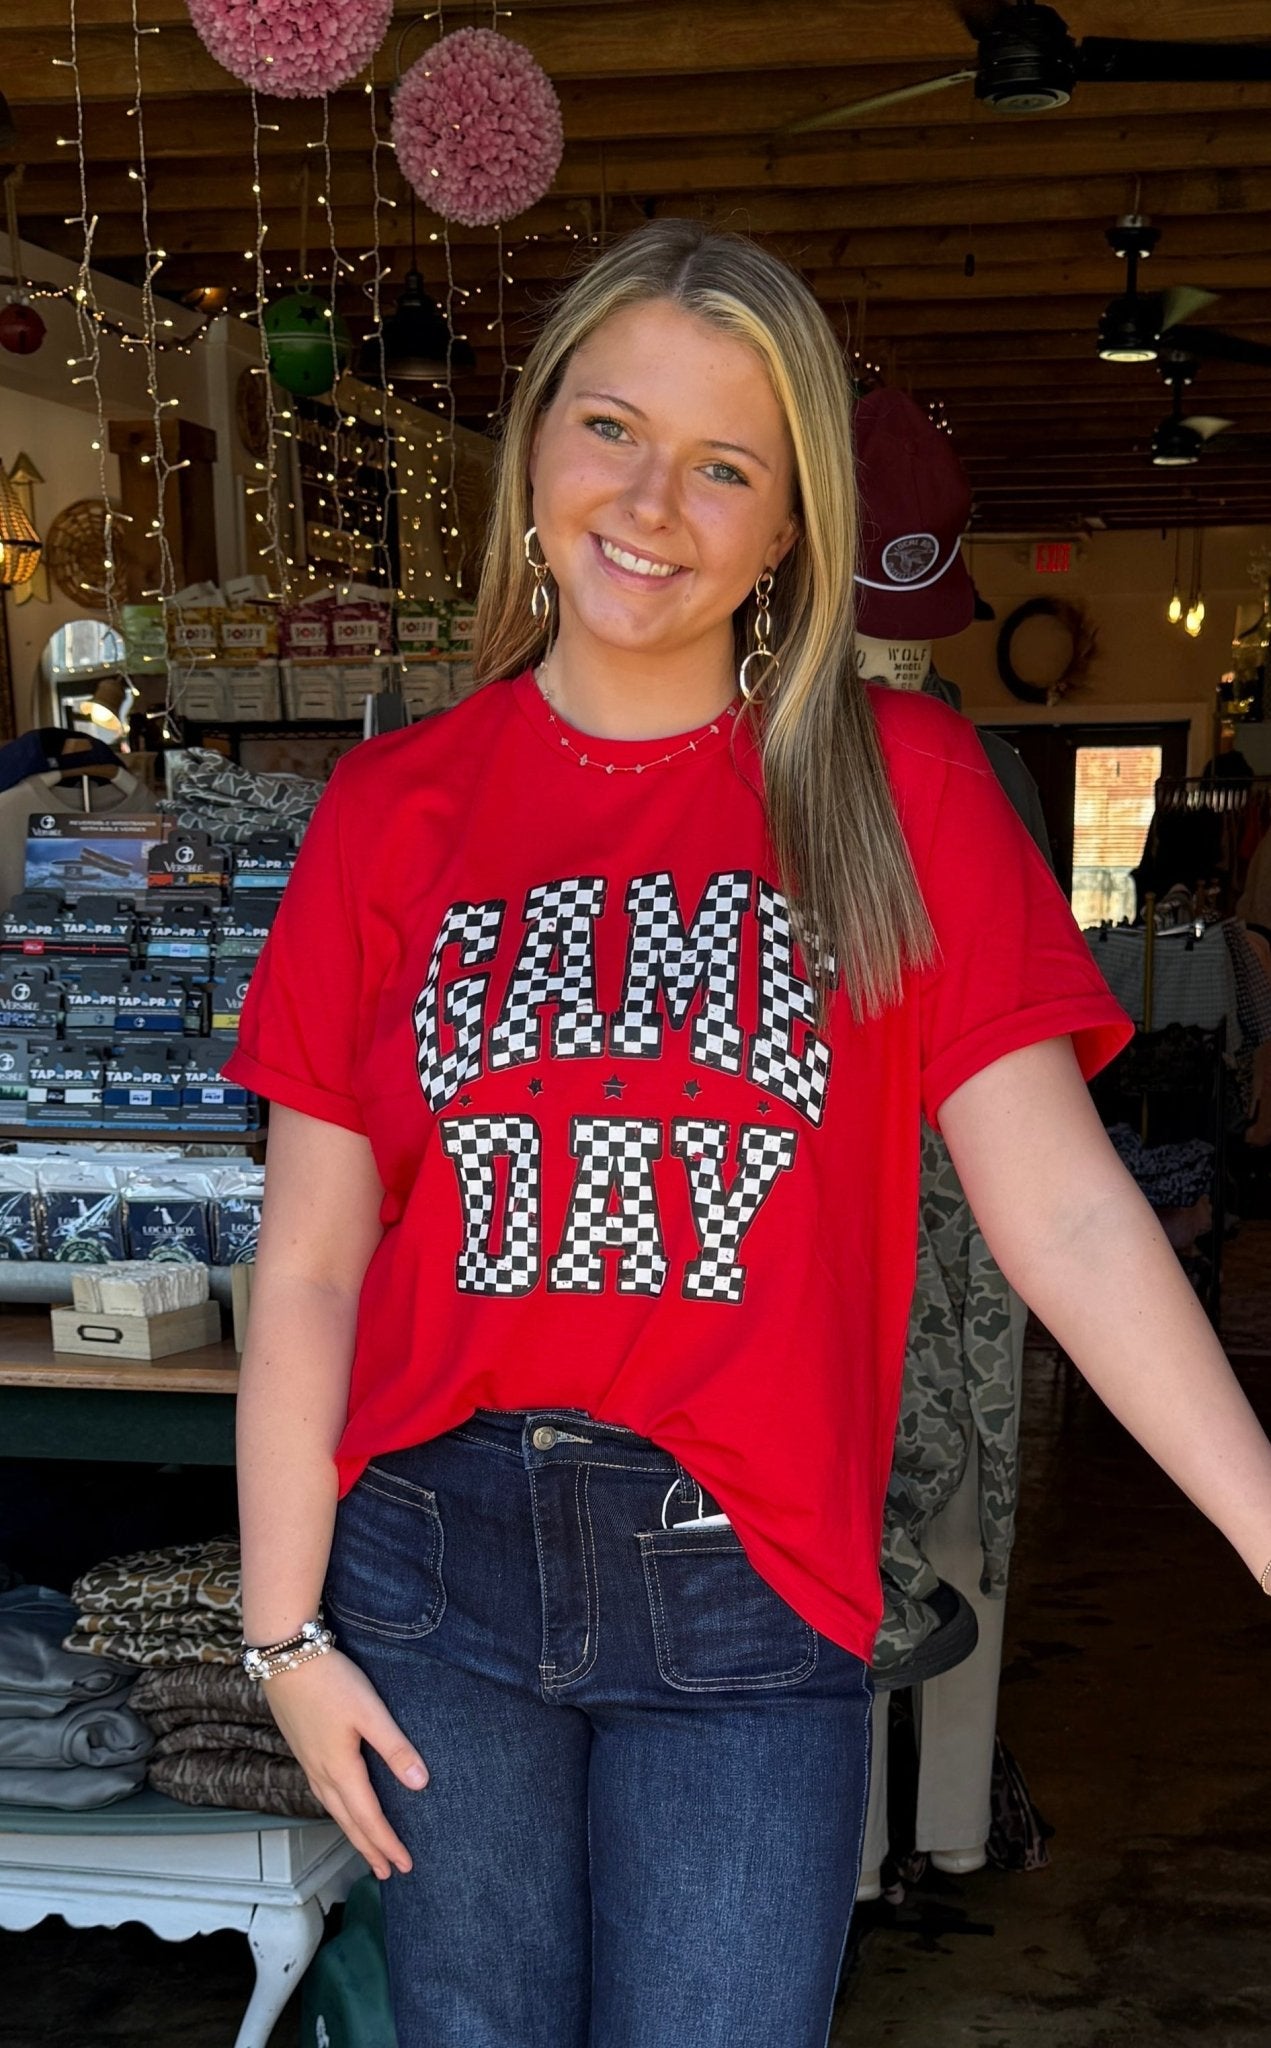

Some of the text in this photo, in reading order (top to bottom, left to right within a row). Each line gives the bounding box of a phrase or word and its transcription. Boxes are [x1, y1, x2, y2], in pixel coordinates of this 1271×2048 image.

[1036, 544, 1071, 573] EXIT
[888, 647, 927, 661] WOLF
[894, 662, 922, 671] MODEL
[896, 673, 919, 681] FORM
[163, 860, 204, 873] VERSIBLE
[236, 858, 259, 869] TAP
[4, 925, 28, 934] TAP
[35, 925, 61, 935] PRA
[62, 923, 87, 933] TAP
[95, 924, 128, 935] PRAY
[150, 927, 172, 936] TAP
[180, 928, 211, 938] PRAY
[223, 927, 245, 936] TAP
[252, 928, 270, 937] PR
[67, 995, 90, 1005] TAP
[100, 995, 116, 1005] PR
[118, 997, 141, 1007] TAP
[149, 998, 183, 1008] PRAY
[412, 870, 838, 1129] GAME
[30, 1069, 56, 1080] TAP
[64, 1070, 100, 1081] PRAY
[105, 1071, 133, 1082] TAP
[142, 1073, 182, 1084] PRAY
[185, 1072, 208, 1082] TAP
[439, 1114, 798, 1305] DAY
[142, 1226, 197, 1235] LOCAL BOY
